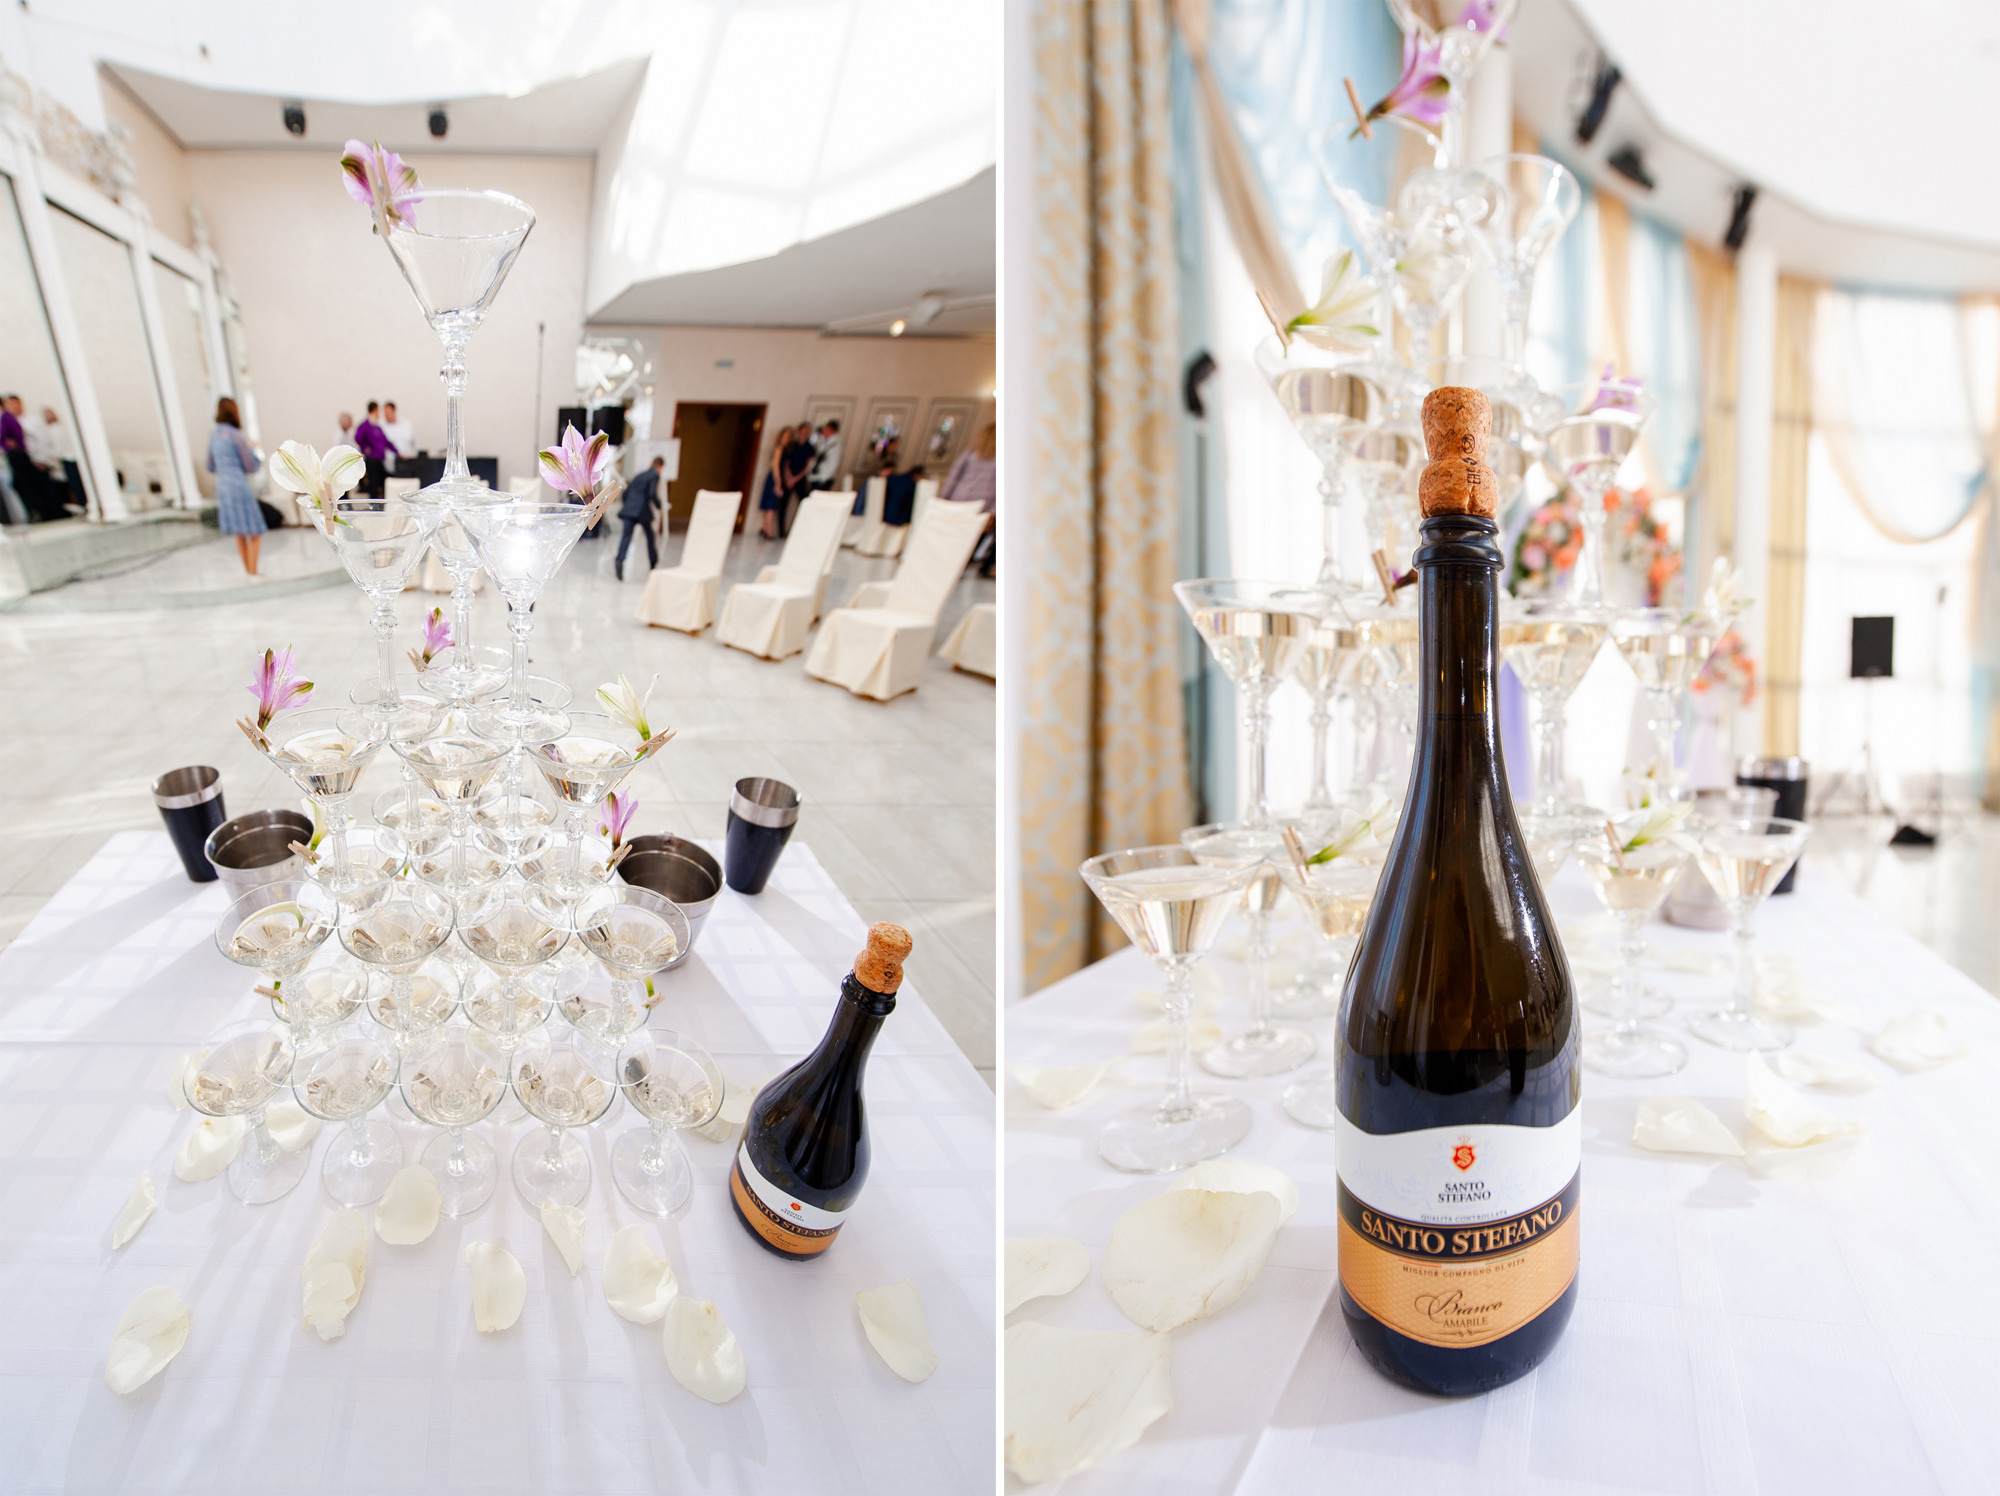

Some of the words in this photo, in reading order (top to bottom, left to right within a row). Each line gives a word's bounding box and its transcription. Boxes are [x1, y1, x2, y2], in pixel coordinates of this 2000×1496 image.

[1445, 1181, 1485, 1193] SANTO
[1437, 1190, 1491, 1204] STEFANO
[745, 1184, 780, 1226] SANTO
[781, 1219, 836, 1237] STEFANO
[1455, 1209, 1509, 1223] CONTROLLATA
[1361, 1210, 1446, 1255] SANTO
[1452, 1200, 1563, 1255] STEFANO
[1402, 1265, 1439, 1277] MIGLIOR
[1443, 1268, 1492, 1278] COMPAGNO
[1494, 1264, 1505, 1273] DI
[1507, 1257, 1526, 1270] VITA
[1414, 1289, 1504, 1324] Bianco
[1443, 1316, 1489, 1329] AMABILE
